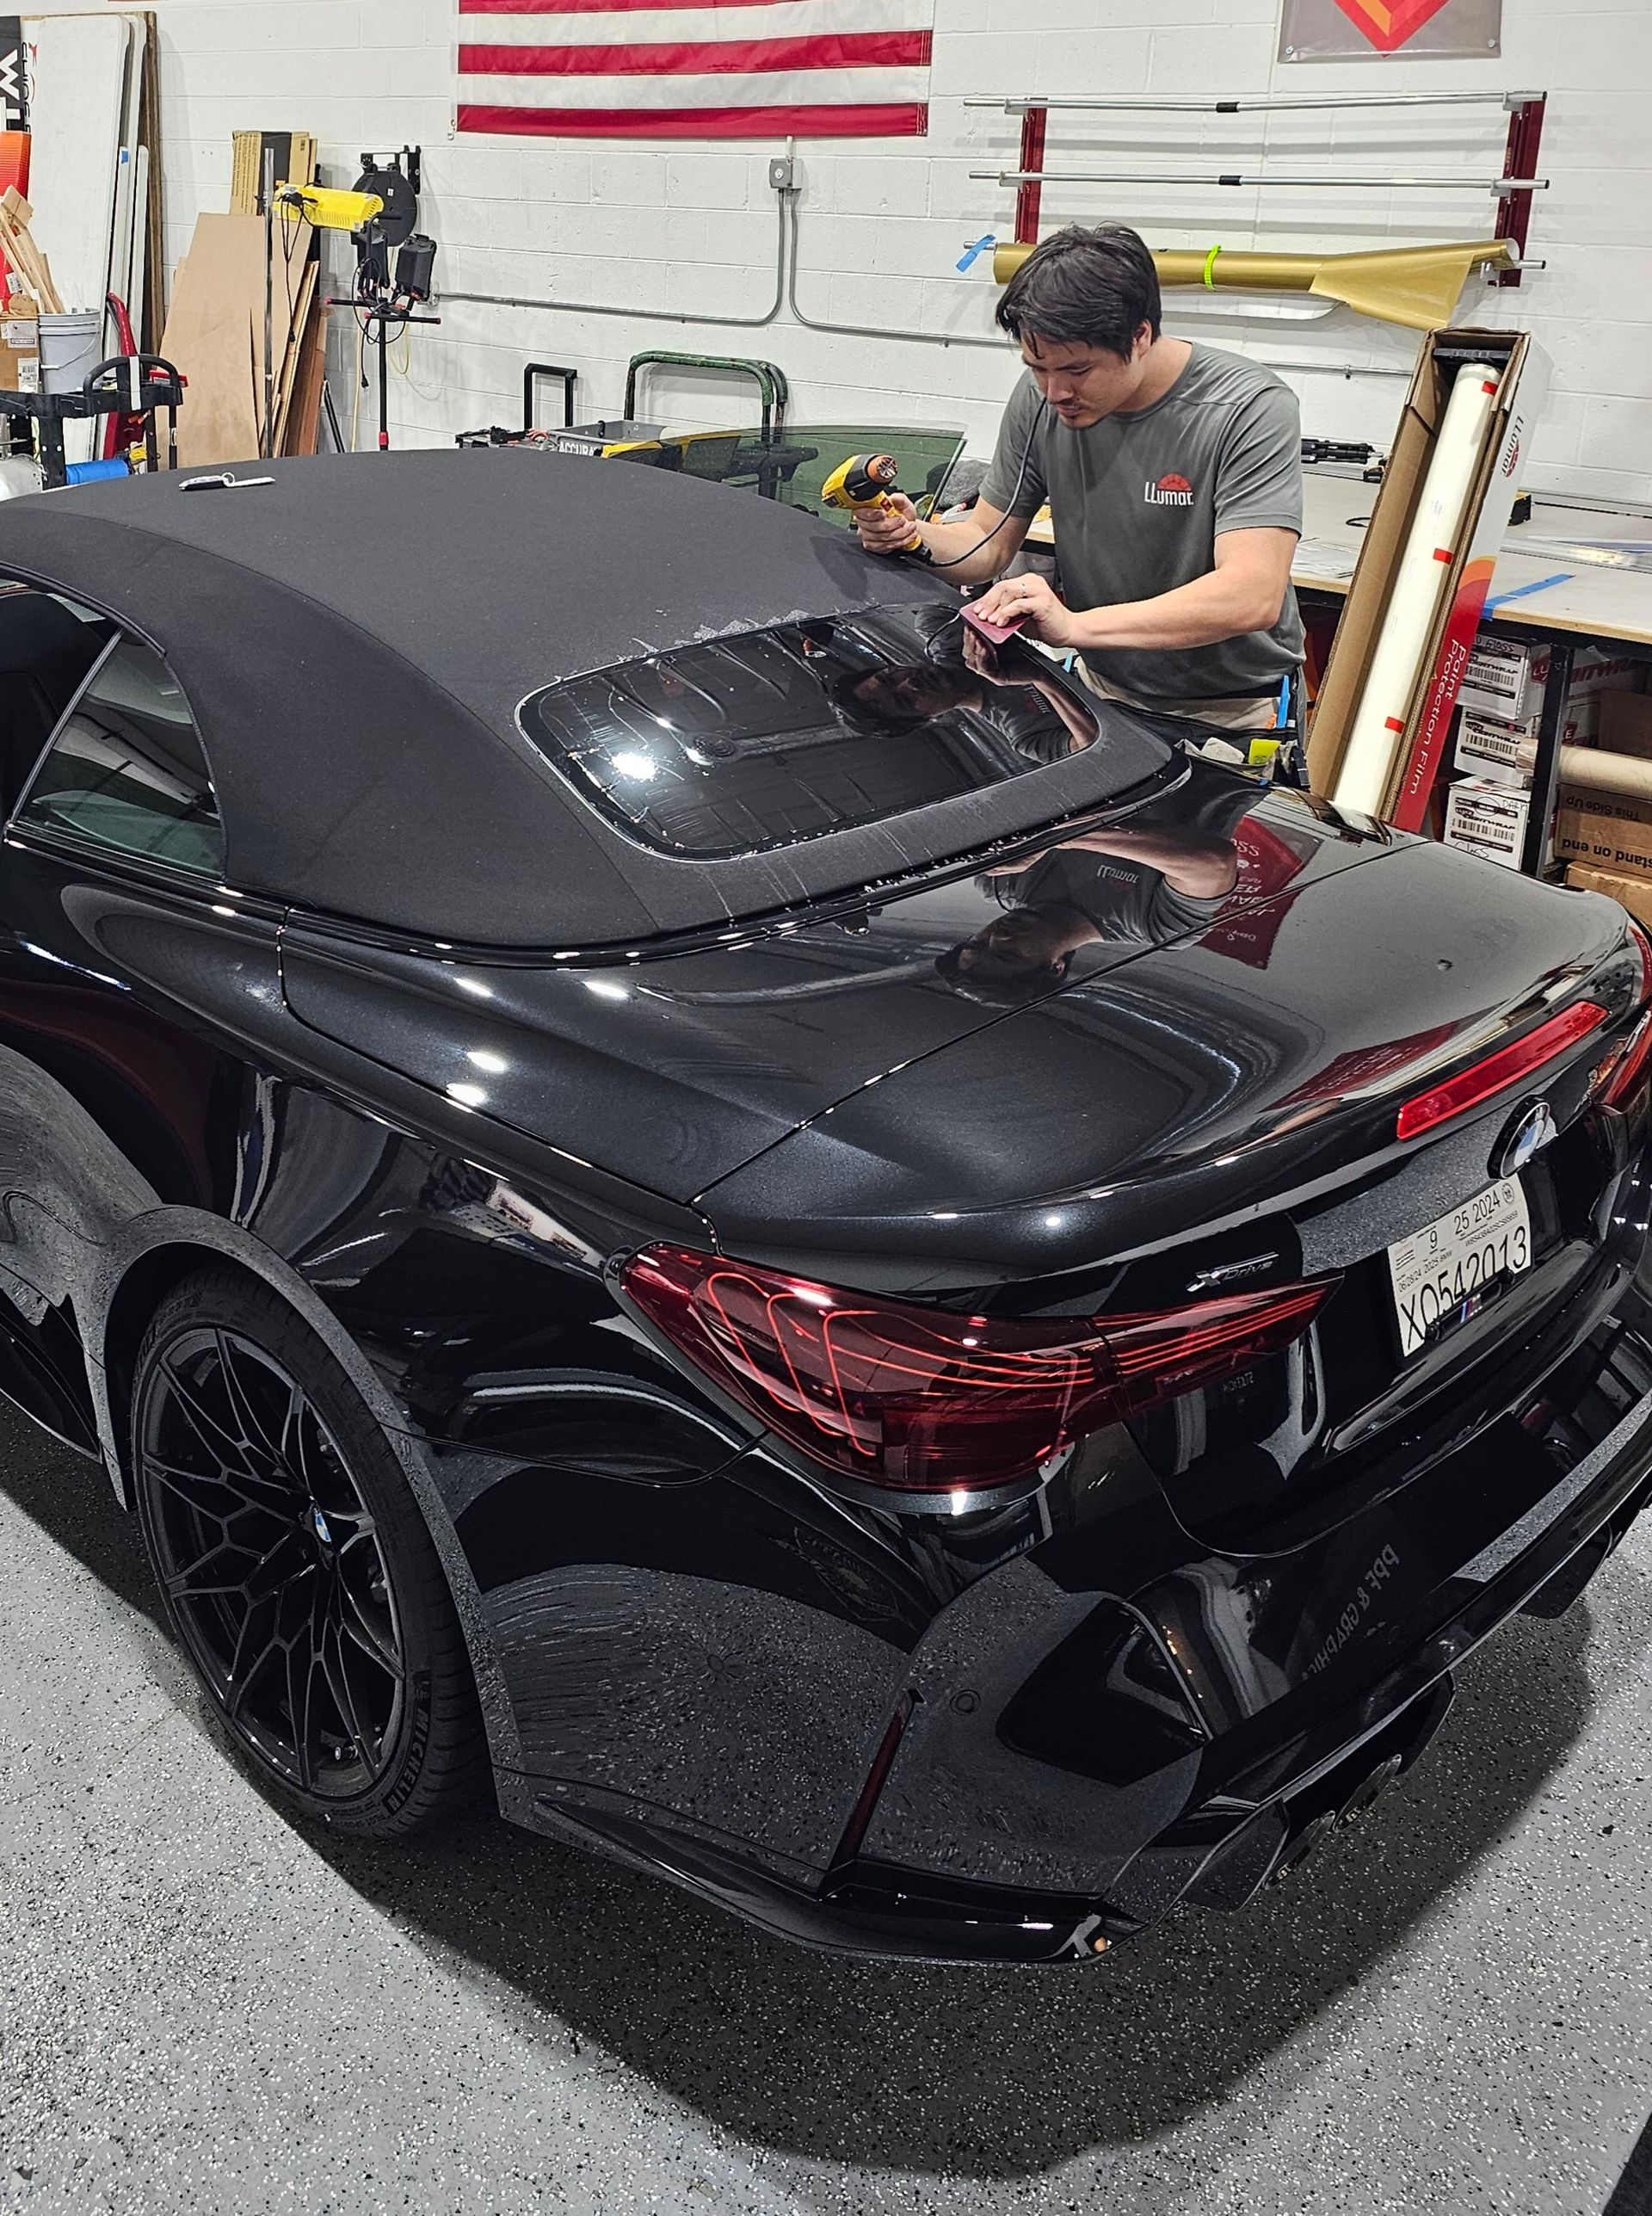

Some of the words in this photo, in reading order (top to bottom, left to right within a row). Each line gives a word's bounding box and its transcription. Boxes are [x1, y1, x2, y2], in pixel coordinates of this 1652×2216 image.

[558, 441, 598, 456] ACCURA
[1143, 481, 1194, 506] LLumar
[1446, 645, 1466, 700] Paint
[1424, 639, 1459, 745] Protection
[1410, 750, 1428, 794] Film
[1567, 795, 1584, 809] Up
[1586, 800, 1612, 815] Side
[1562, 838, 1589, 852] end
[1593, 844, 1612, 857] on
[1430, 1230, 1438, 1249] 9
[1454, 1209, 1470, 1236] 25
[1472, 1189, 1501, 1224] 2024
[387, 1707, 429, 1812] MICHELIN
